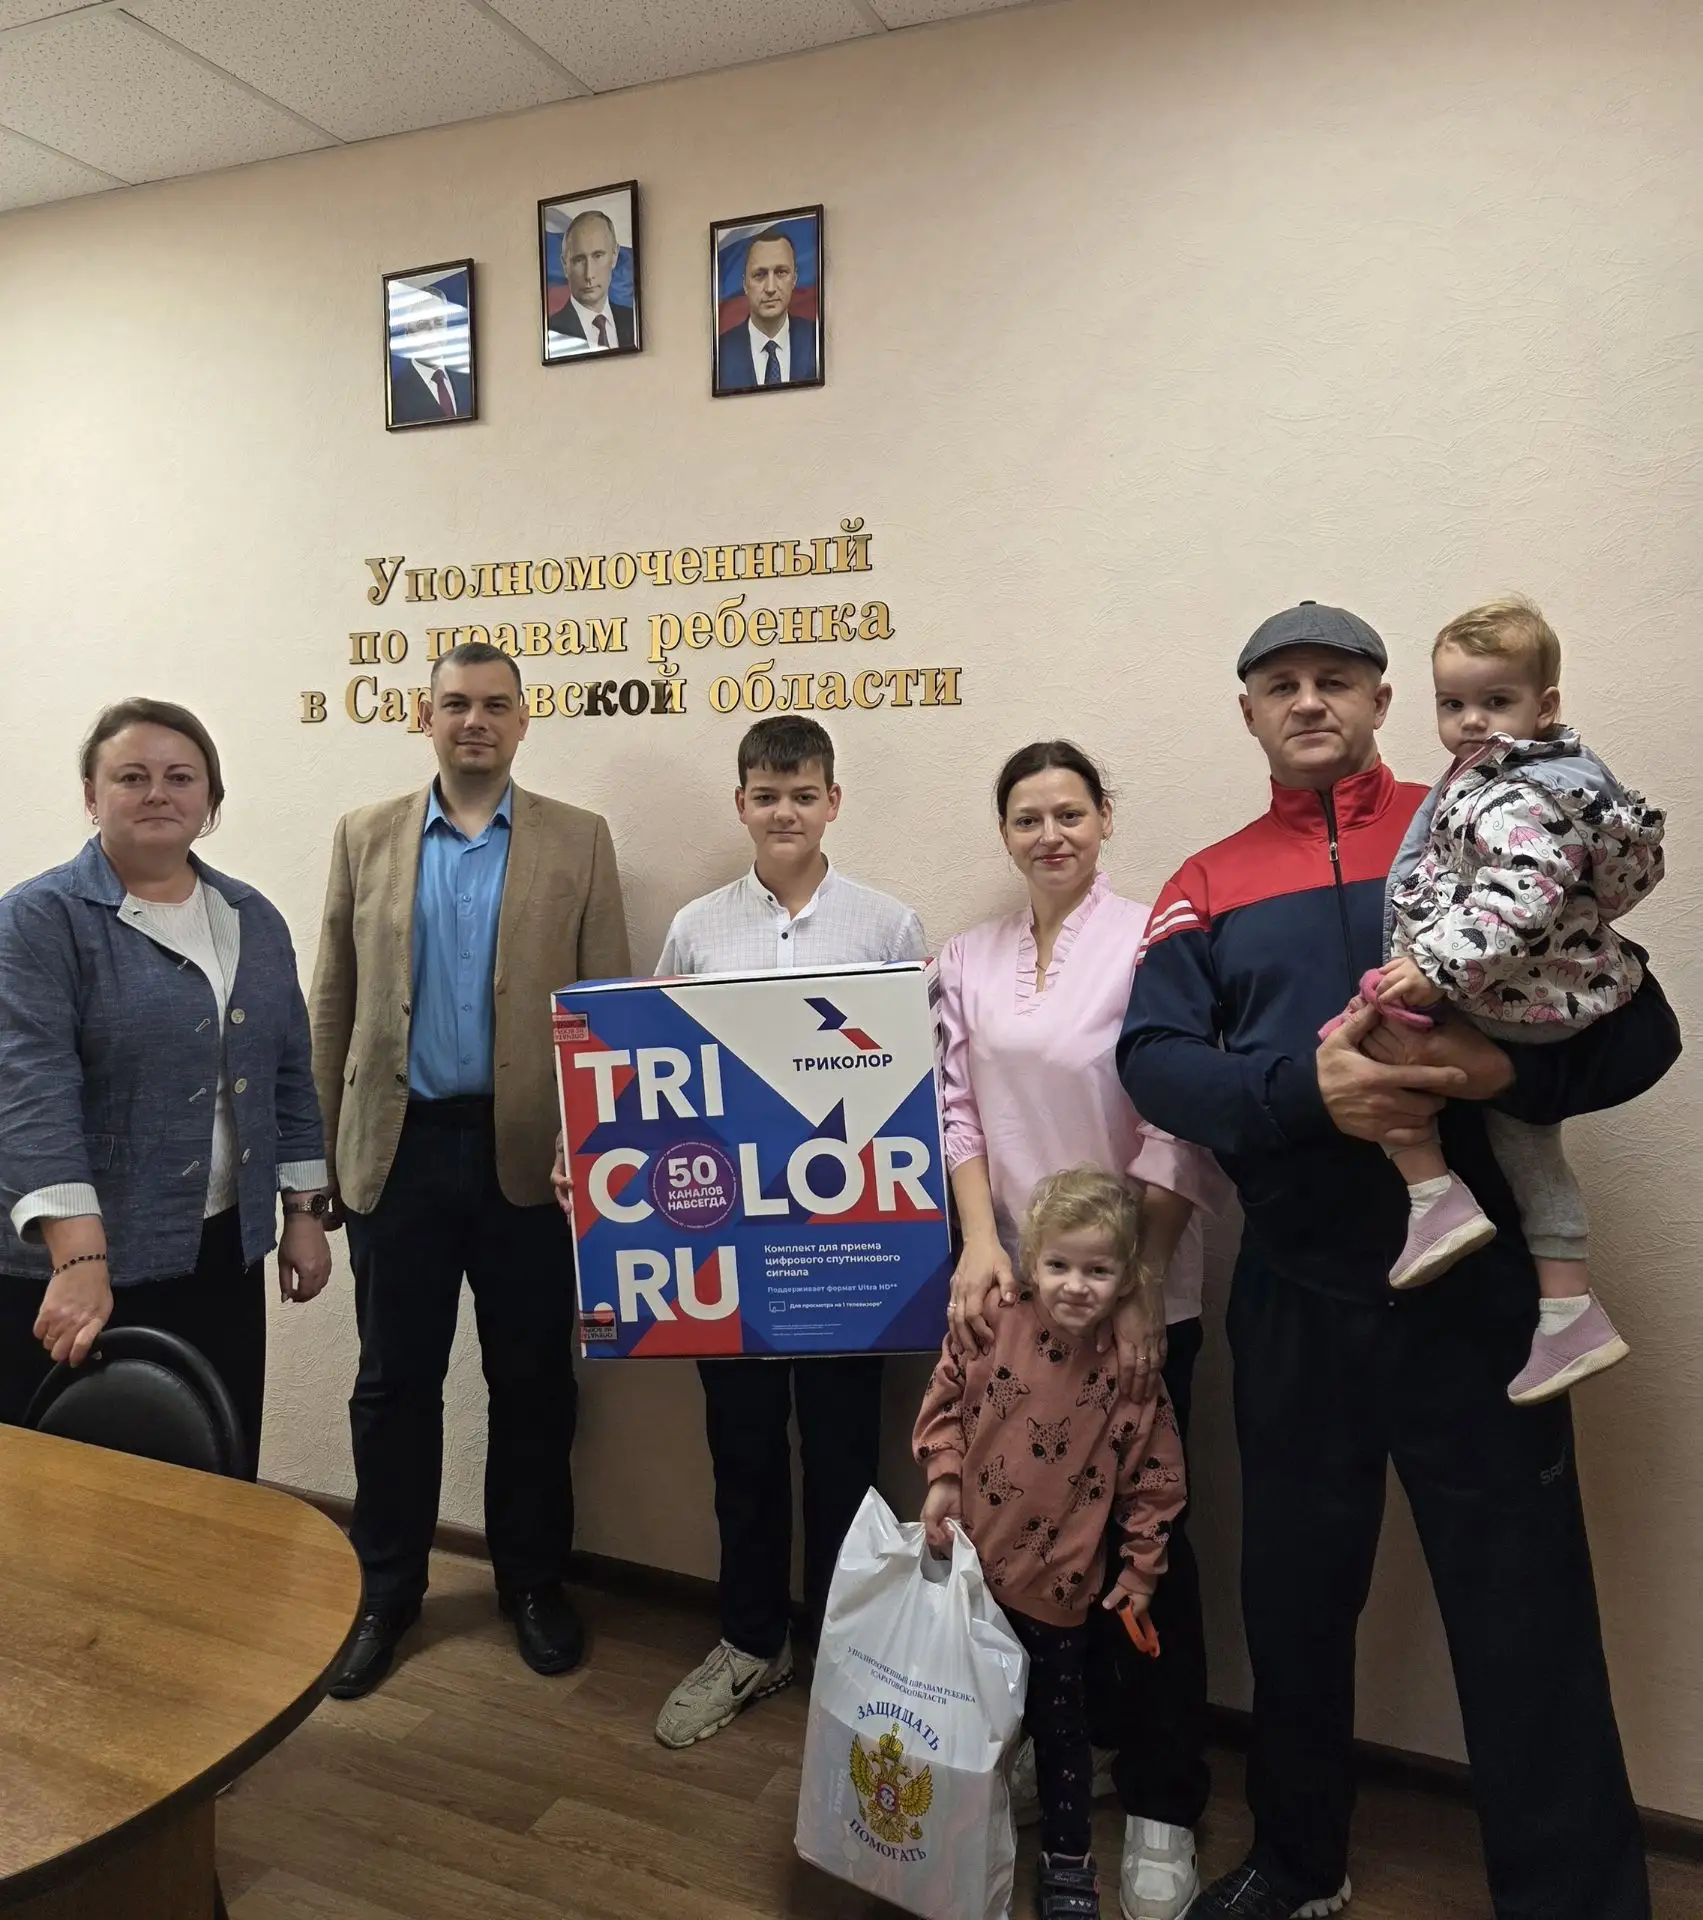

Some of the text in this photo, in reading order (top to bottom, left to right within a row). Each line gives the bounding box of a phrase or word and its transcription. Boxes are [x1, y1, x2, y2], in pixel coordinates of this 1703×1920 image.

[364, 517, 873, 606] Уполномоченный
[348, 628, 408, 665] по
[647, 593, 895, 663] ребенка
[299, 688, 328, 723] в
[707, 659, 963, 715] области
[792, 1053, 893, 1072] ТРИКОЛОР
[573, 1043, 725, 1123] TRI
[667, 1155, 718, 1188] 50
[668, 1186, 724, 1200] КАНАЛОВ
[668, 1197, 727, 1211] НАВСЕГДА
[764, 1241, 881, 1253] Комплект для приема
[765, 1253, 901, 1266] цифрового спутникового
[766, 1268, 809, 1277] сигнала
[767, 1285, 825, 1294] Поддерживает
[826, 1284, 857, 1293] формат
[857, 1283, 878, 1291] Ultra
[912, 1690, 947, 1705] ОБЛАСТИ
[943, 1688, 977, 1704] РЕБЕНКА
[857, 1701, 940, 1751] ЗАЩИЩАТЬ
[848, 1818, 927, 1862] ПОМОГАТЬ
